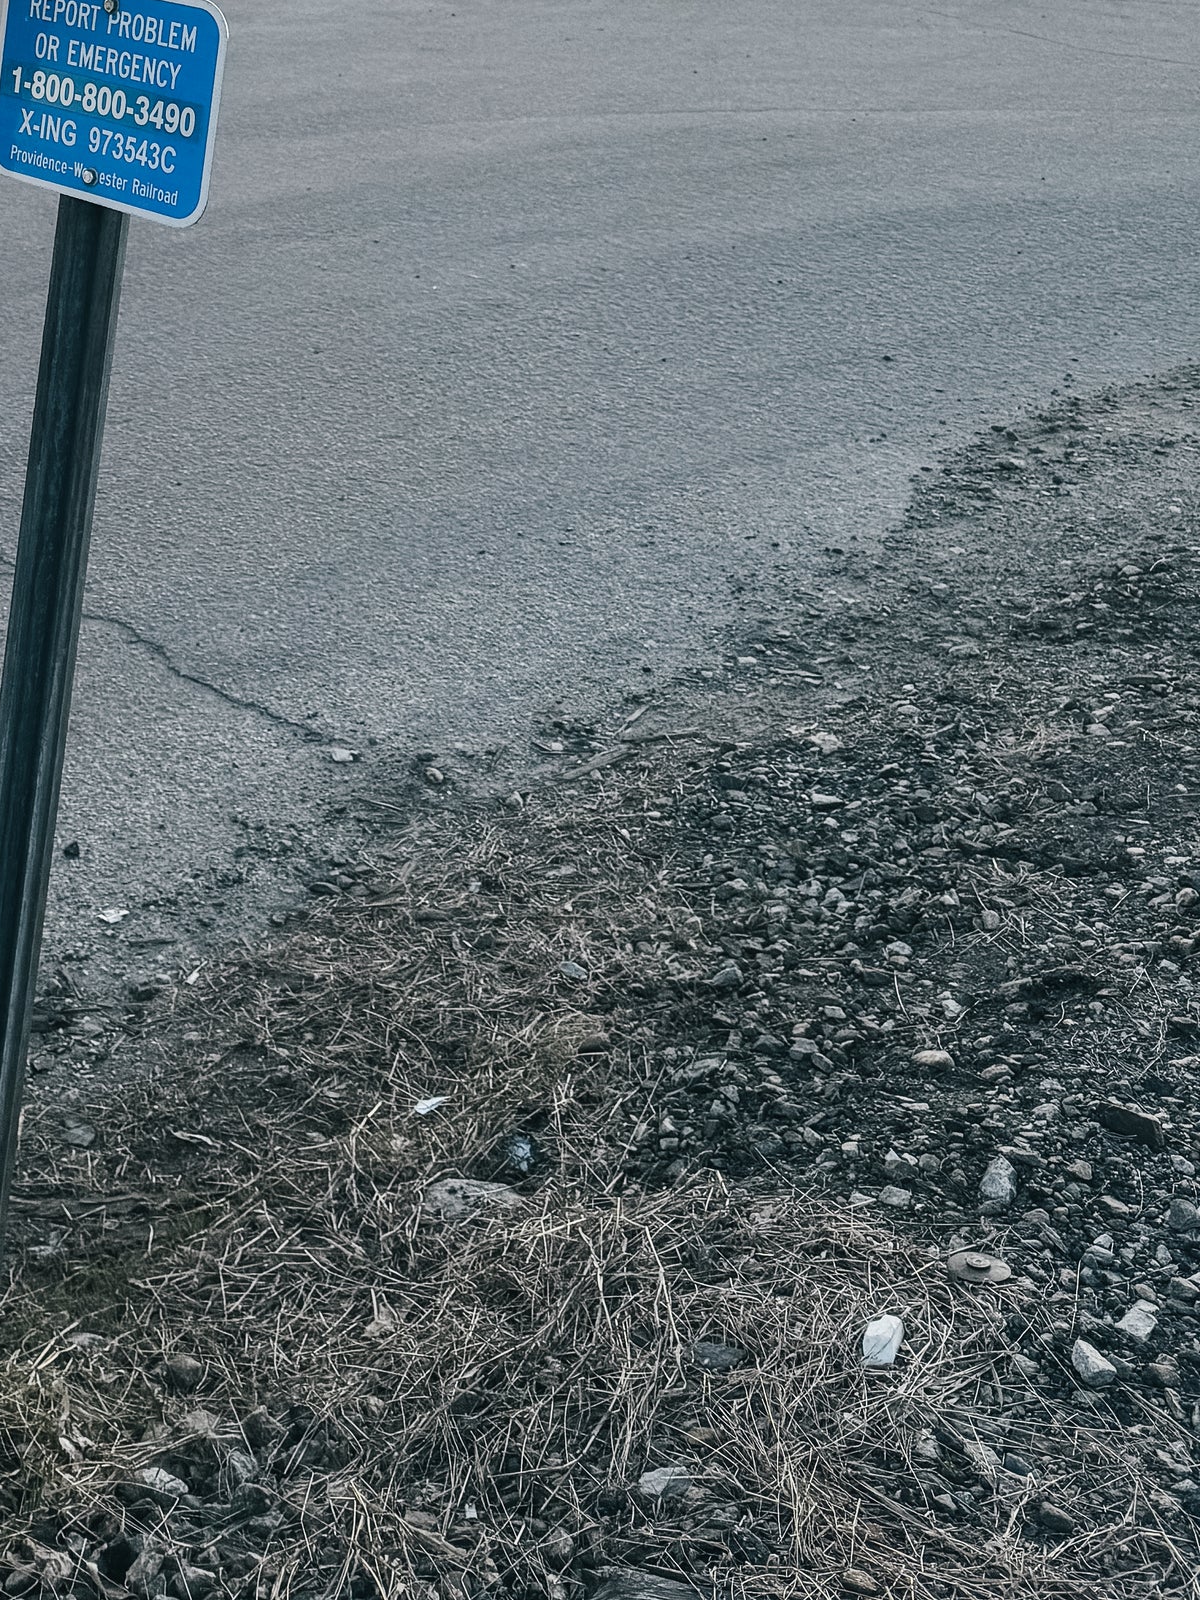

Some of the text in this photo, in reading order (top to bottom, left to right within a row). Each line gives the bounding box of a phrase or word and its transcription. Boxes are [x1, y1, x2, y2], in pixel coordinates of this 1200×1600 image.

[35, 32, 182, 90] OR EMERGENCY
[106, 10, 198, 53] PROBLEM
[12, 66, 196, 138] 1-800-800-3490
[18, 108, 178, 174] X-ING 973543C
[10, 144, 179, 207] Providence-Wester Railroad
